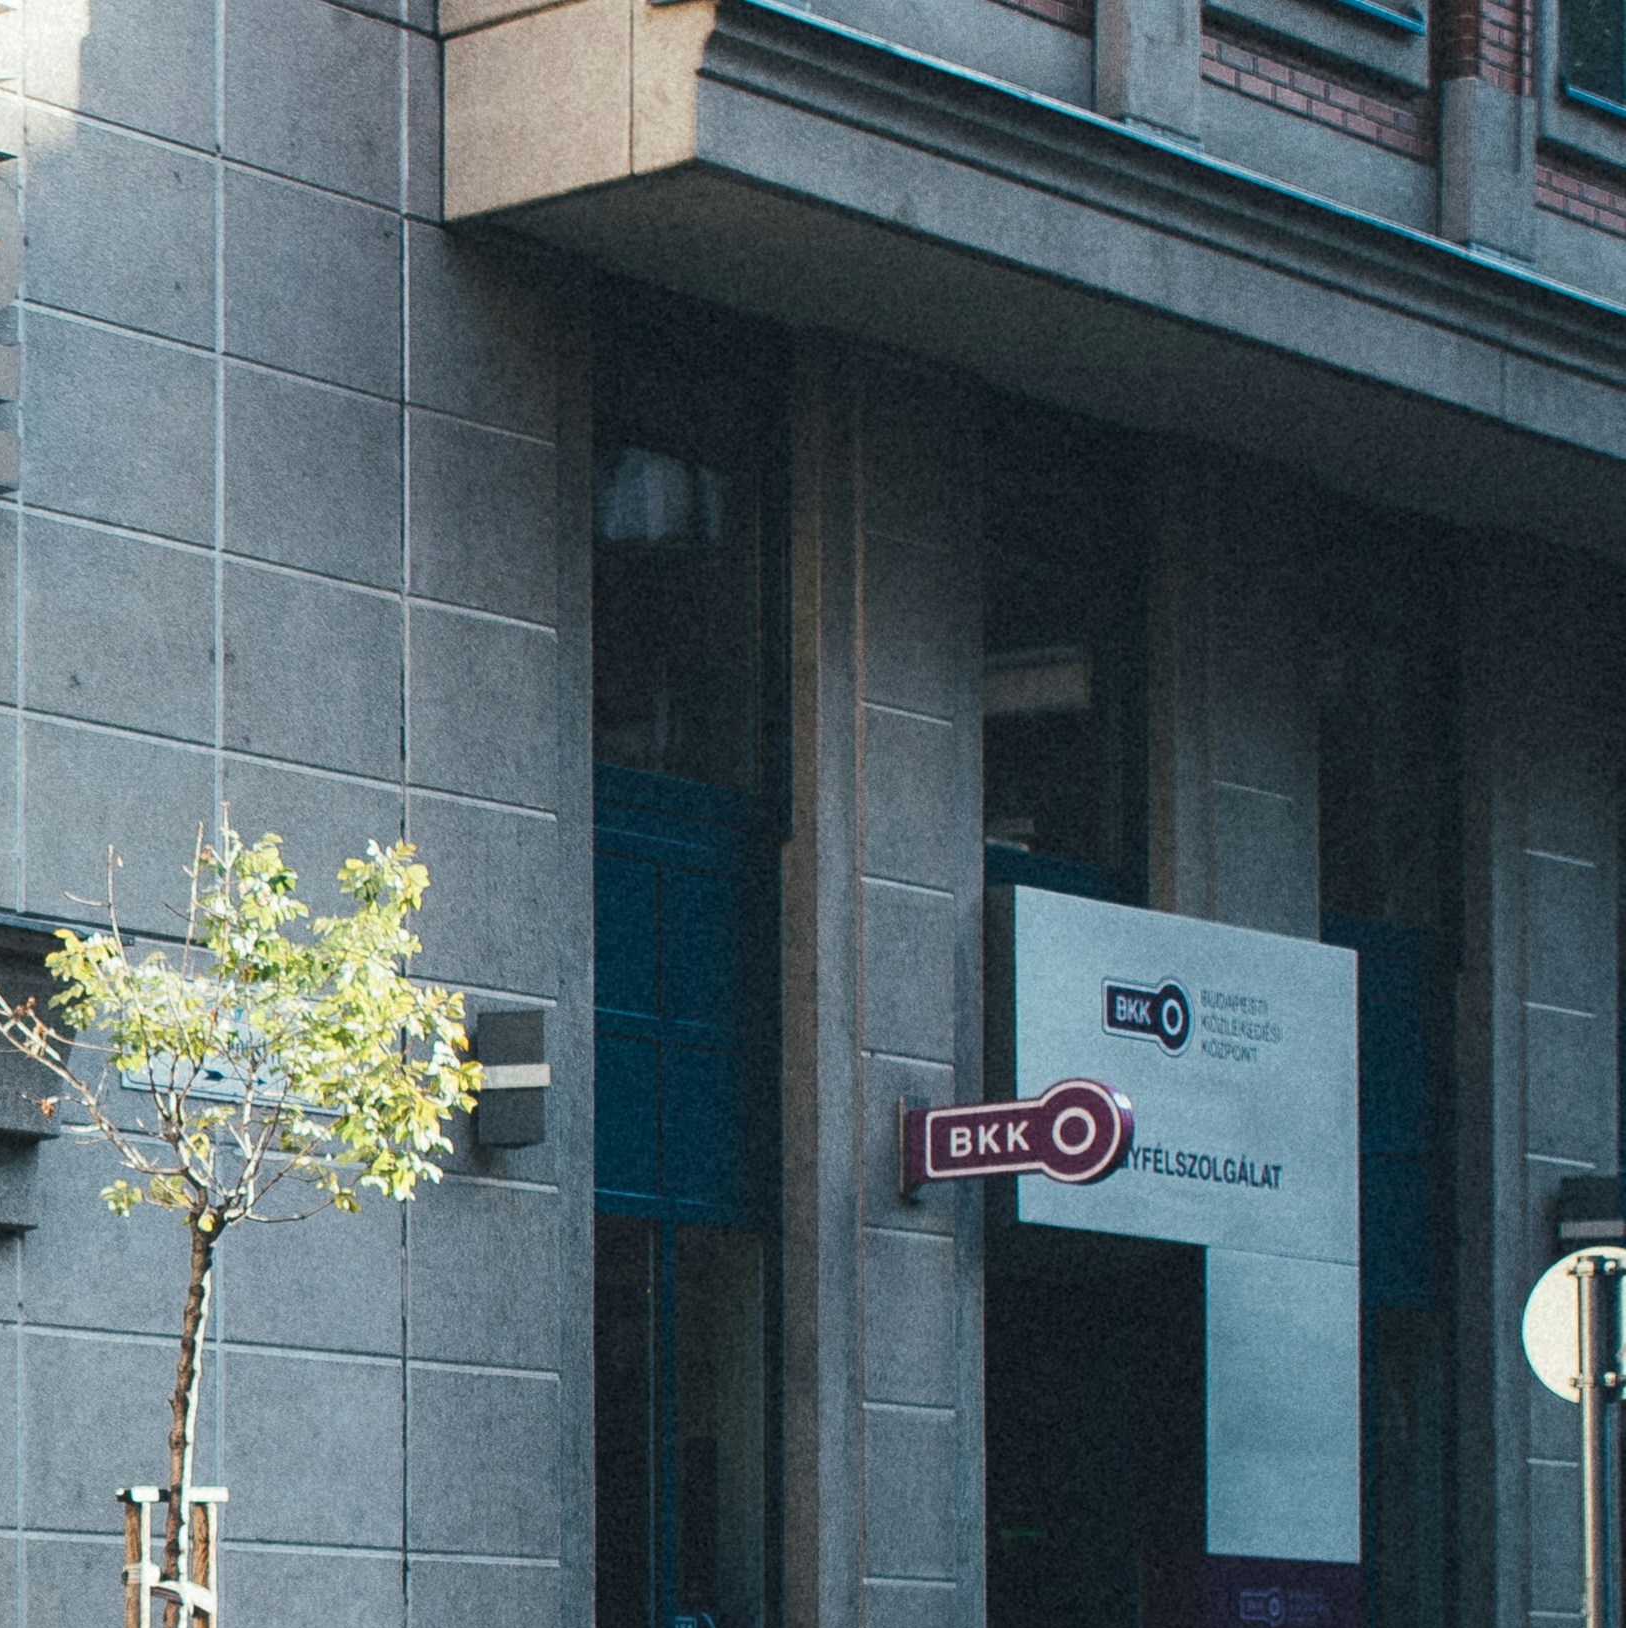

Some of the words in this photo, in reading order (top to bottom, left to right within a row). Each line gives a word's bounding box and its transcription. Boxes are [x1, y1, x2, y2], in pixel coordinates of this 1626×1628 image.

[1115, 995, 1151, 1025] BKK
[1200, 989, 1269, 1017] BUDAPESTI
[1200, 1039, 1259, 1063] KÖZPONT
[949, 1119, 1031, 1158] BKK
[1123, 1142, 1282, 1189] YFÉLSZOLGÁLAT
